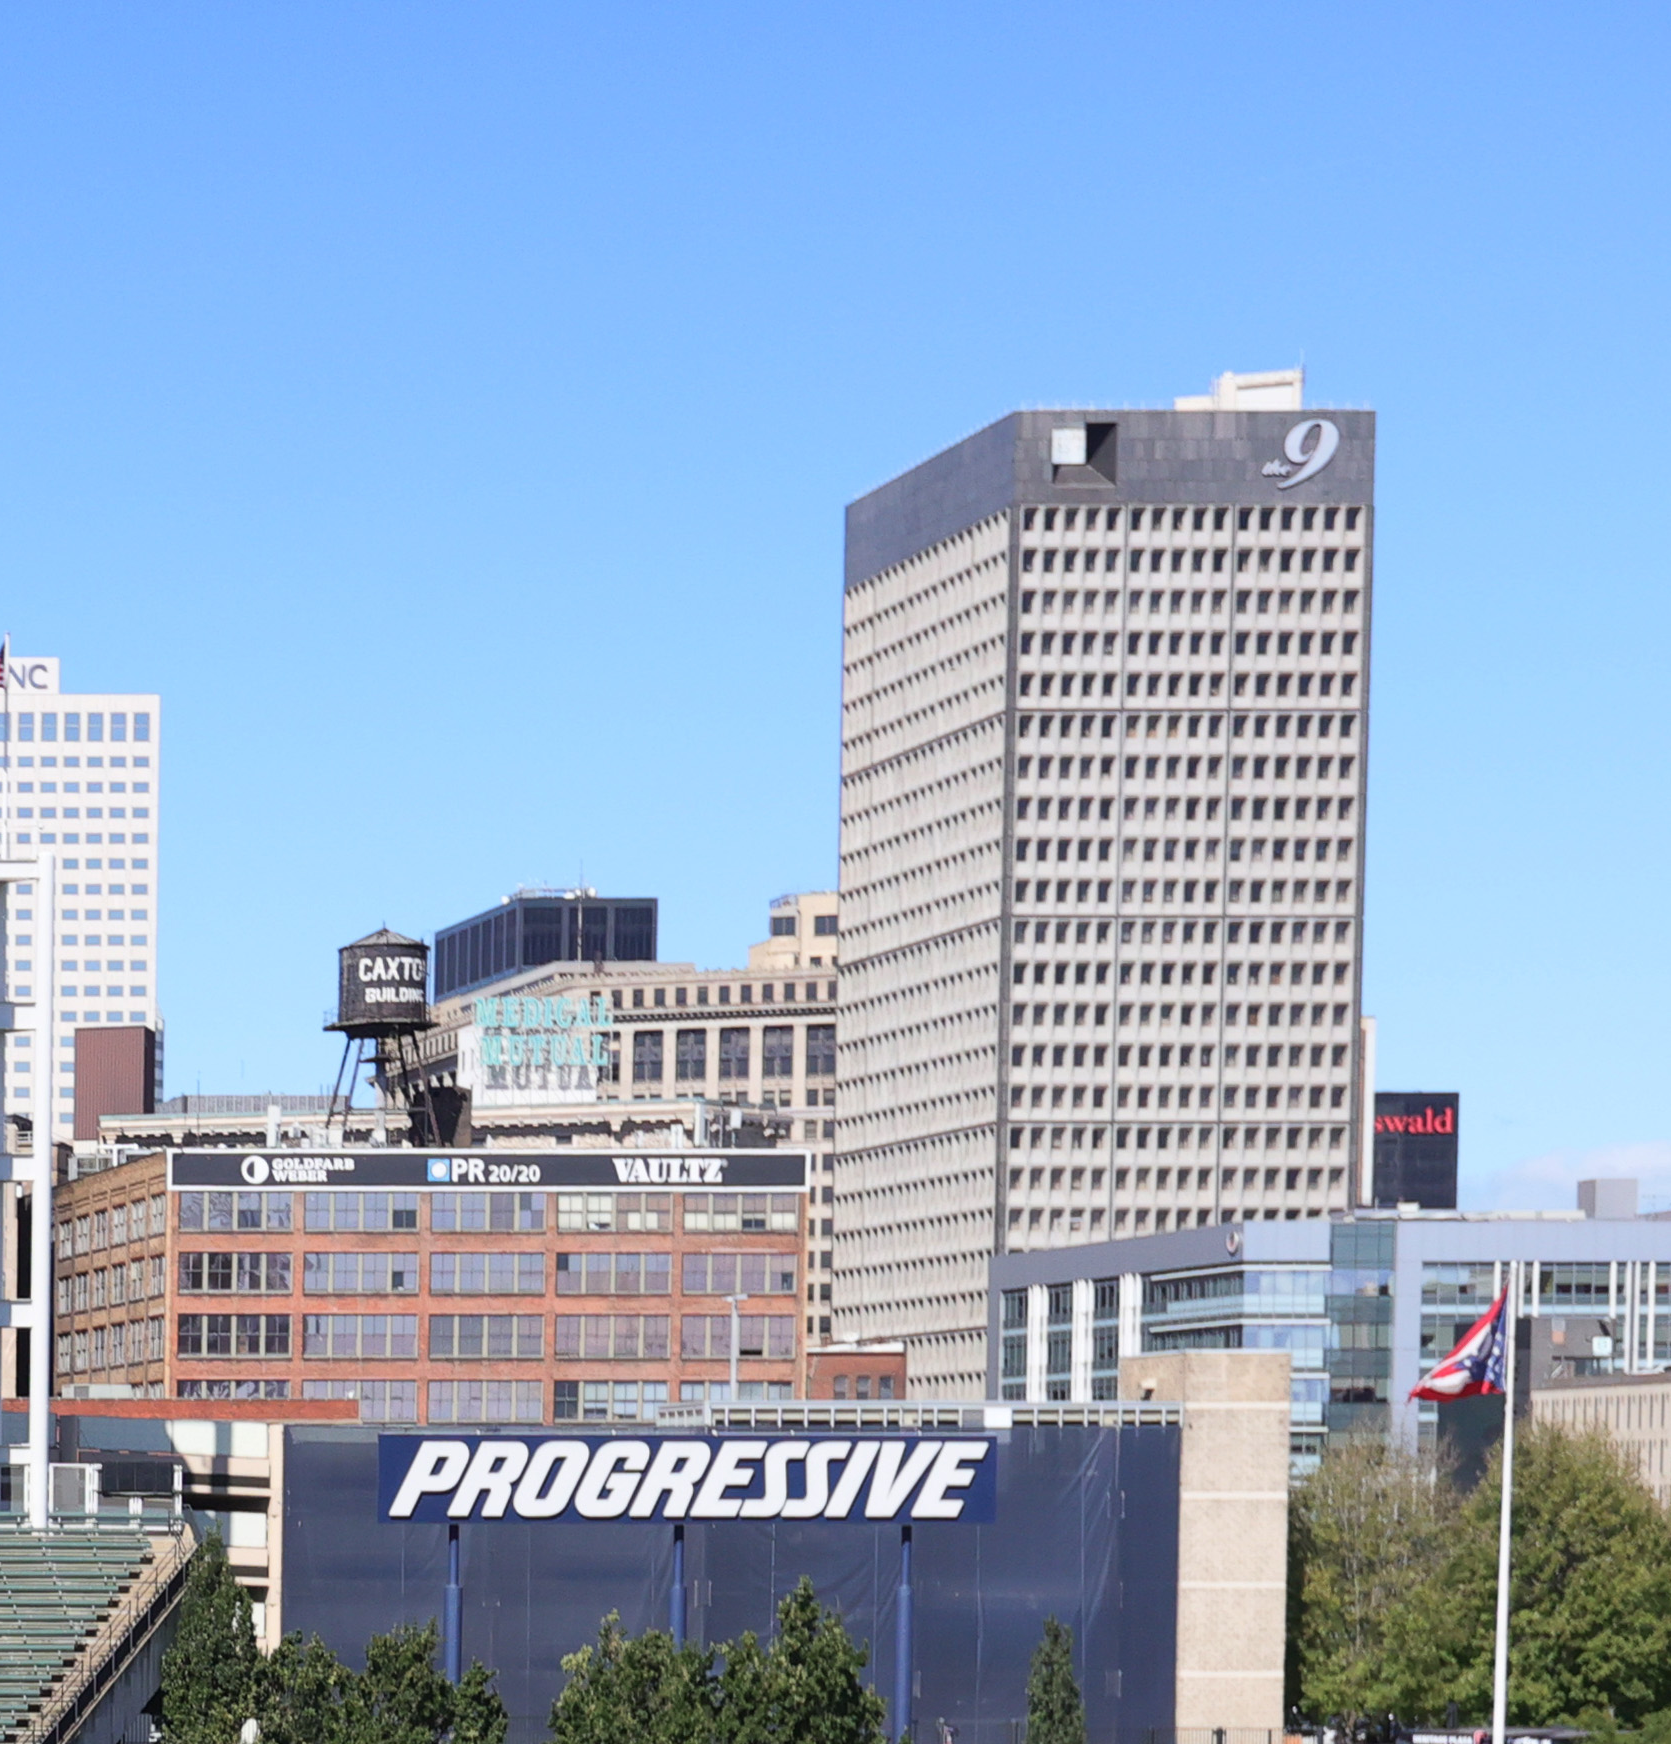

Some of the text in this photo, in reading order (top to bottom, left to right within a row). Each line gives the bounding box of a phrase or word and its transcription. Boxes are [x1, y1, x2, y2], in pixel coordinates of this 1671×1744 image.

[1277, 418, 1340, 490] 9
[359, 955, 426, 982] CAXTO
[473, 996, 613, 1028] MEDICAL
[479, 1031, 608, 1066] MUTUAL
[271, 1157, 355, 1172] GOLDFARB
[271, 1169, 328, 1183] WEBER
[450, 1157, 542, 1184] PR 20/20
[612, 1157, 724, 1183] VAULTZ
[387, 1440, 991, 1520] PROGRESSIVE
